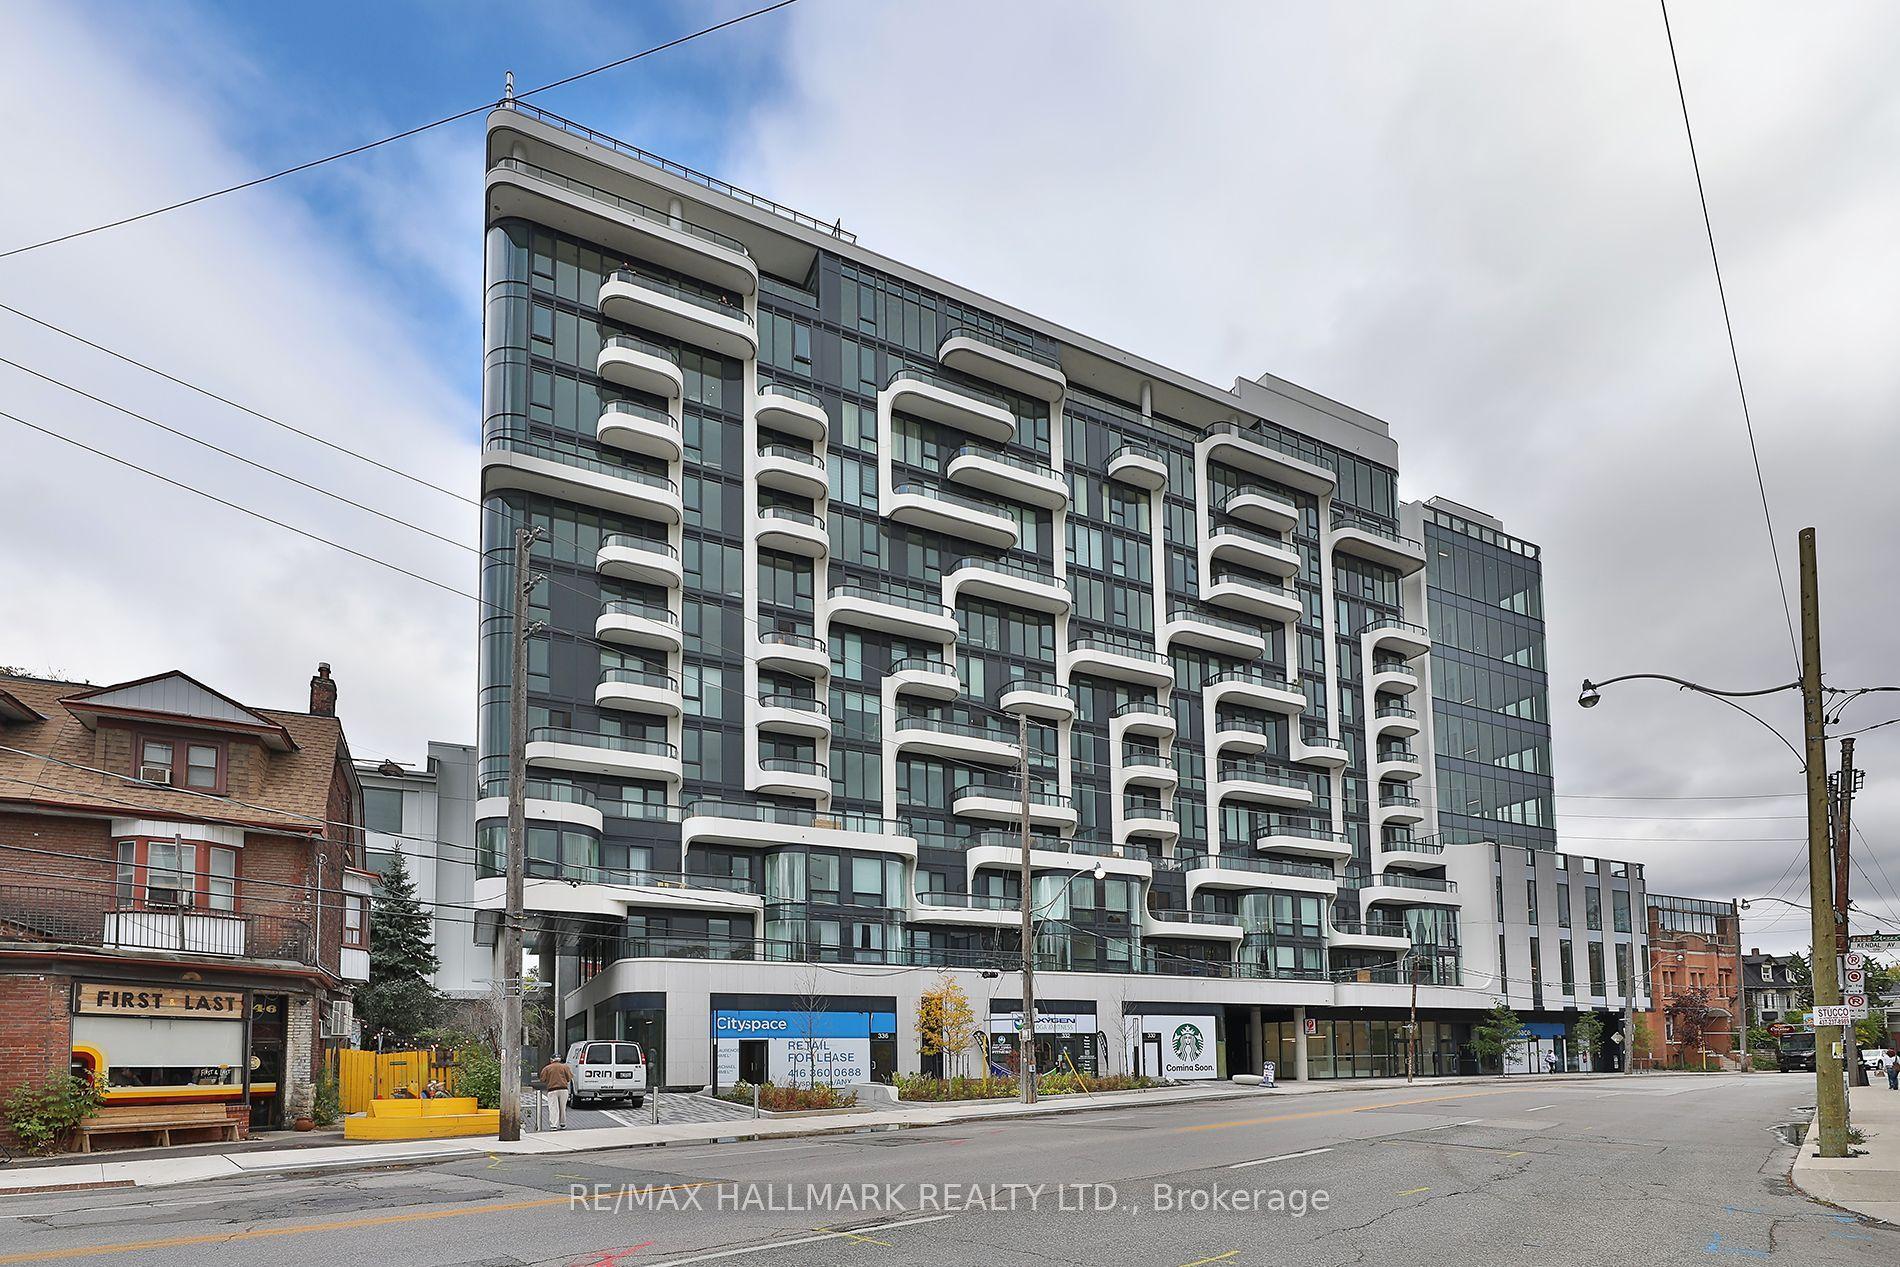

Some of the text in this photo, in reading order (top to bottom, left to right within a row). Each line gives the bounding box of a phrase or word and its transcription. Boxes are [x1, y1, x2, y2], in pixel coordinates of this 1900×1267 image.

[96, 991, 163, 1009] FIRST
[184, 995, 236, 1012] LAST
[1818, 1008, 1849, 1017] STUCCO
[717, 1017, 787, 1032] Cityspace
[788, 1041, 830, 1051] RETAIL
[816, 1053, 855, 1062] LEASE
[788, 1069, 806, 1078] 416
[833, 1068, 862, 1077] 0688
[1194, 1064, 1214, 1072] Soon.
